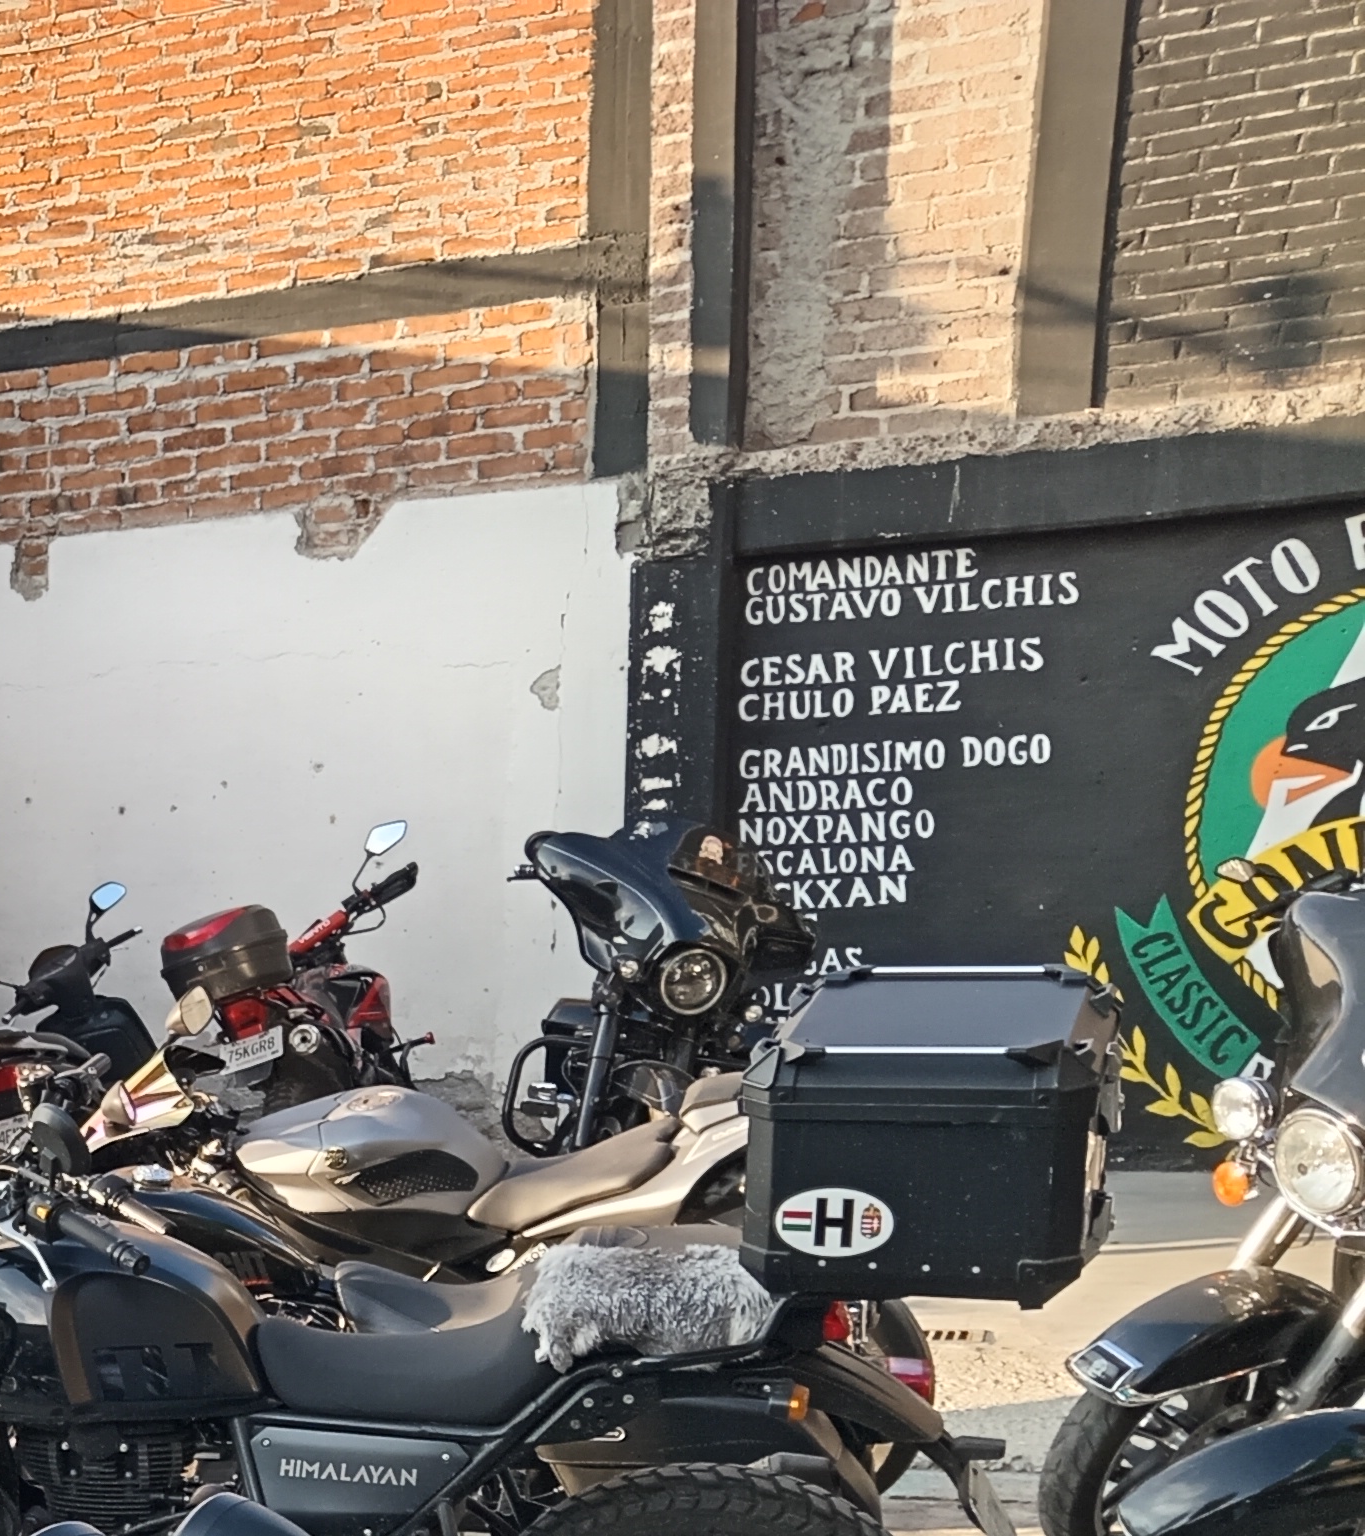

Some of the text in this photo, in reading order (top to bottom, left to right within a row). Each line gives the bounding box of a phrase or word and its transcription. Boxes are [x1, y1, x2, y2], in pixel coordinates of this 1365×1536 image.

[746, 548, 978, 596] COMANDANTE
[745, 571, 1080, 625] GUSTAVO VILCHIS
[1150, 537, 1320, 677] MOTO
[740, 636, 1044, 688] CESAR VILCHIS
[738, 679, 962, 722] CHULO PAEZ
[739, 733, 1052, 779] GRANDISIMO DOGO
[738, 776, 914, 813] ANDRACO
[739, 808, 936, 847] NOXPANGO
[1131, 930, 1250, 1065] CLASSIC
[227, 1036, 275, 1063] 75KGR8
[814, 1197, 855, 1248] H
[279, 1458, 418, 1487] HIMALAYAN
